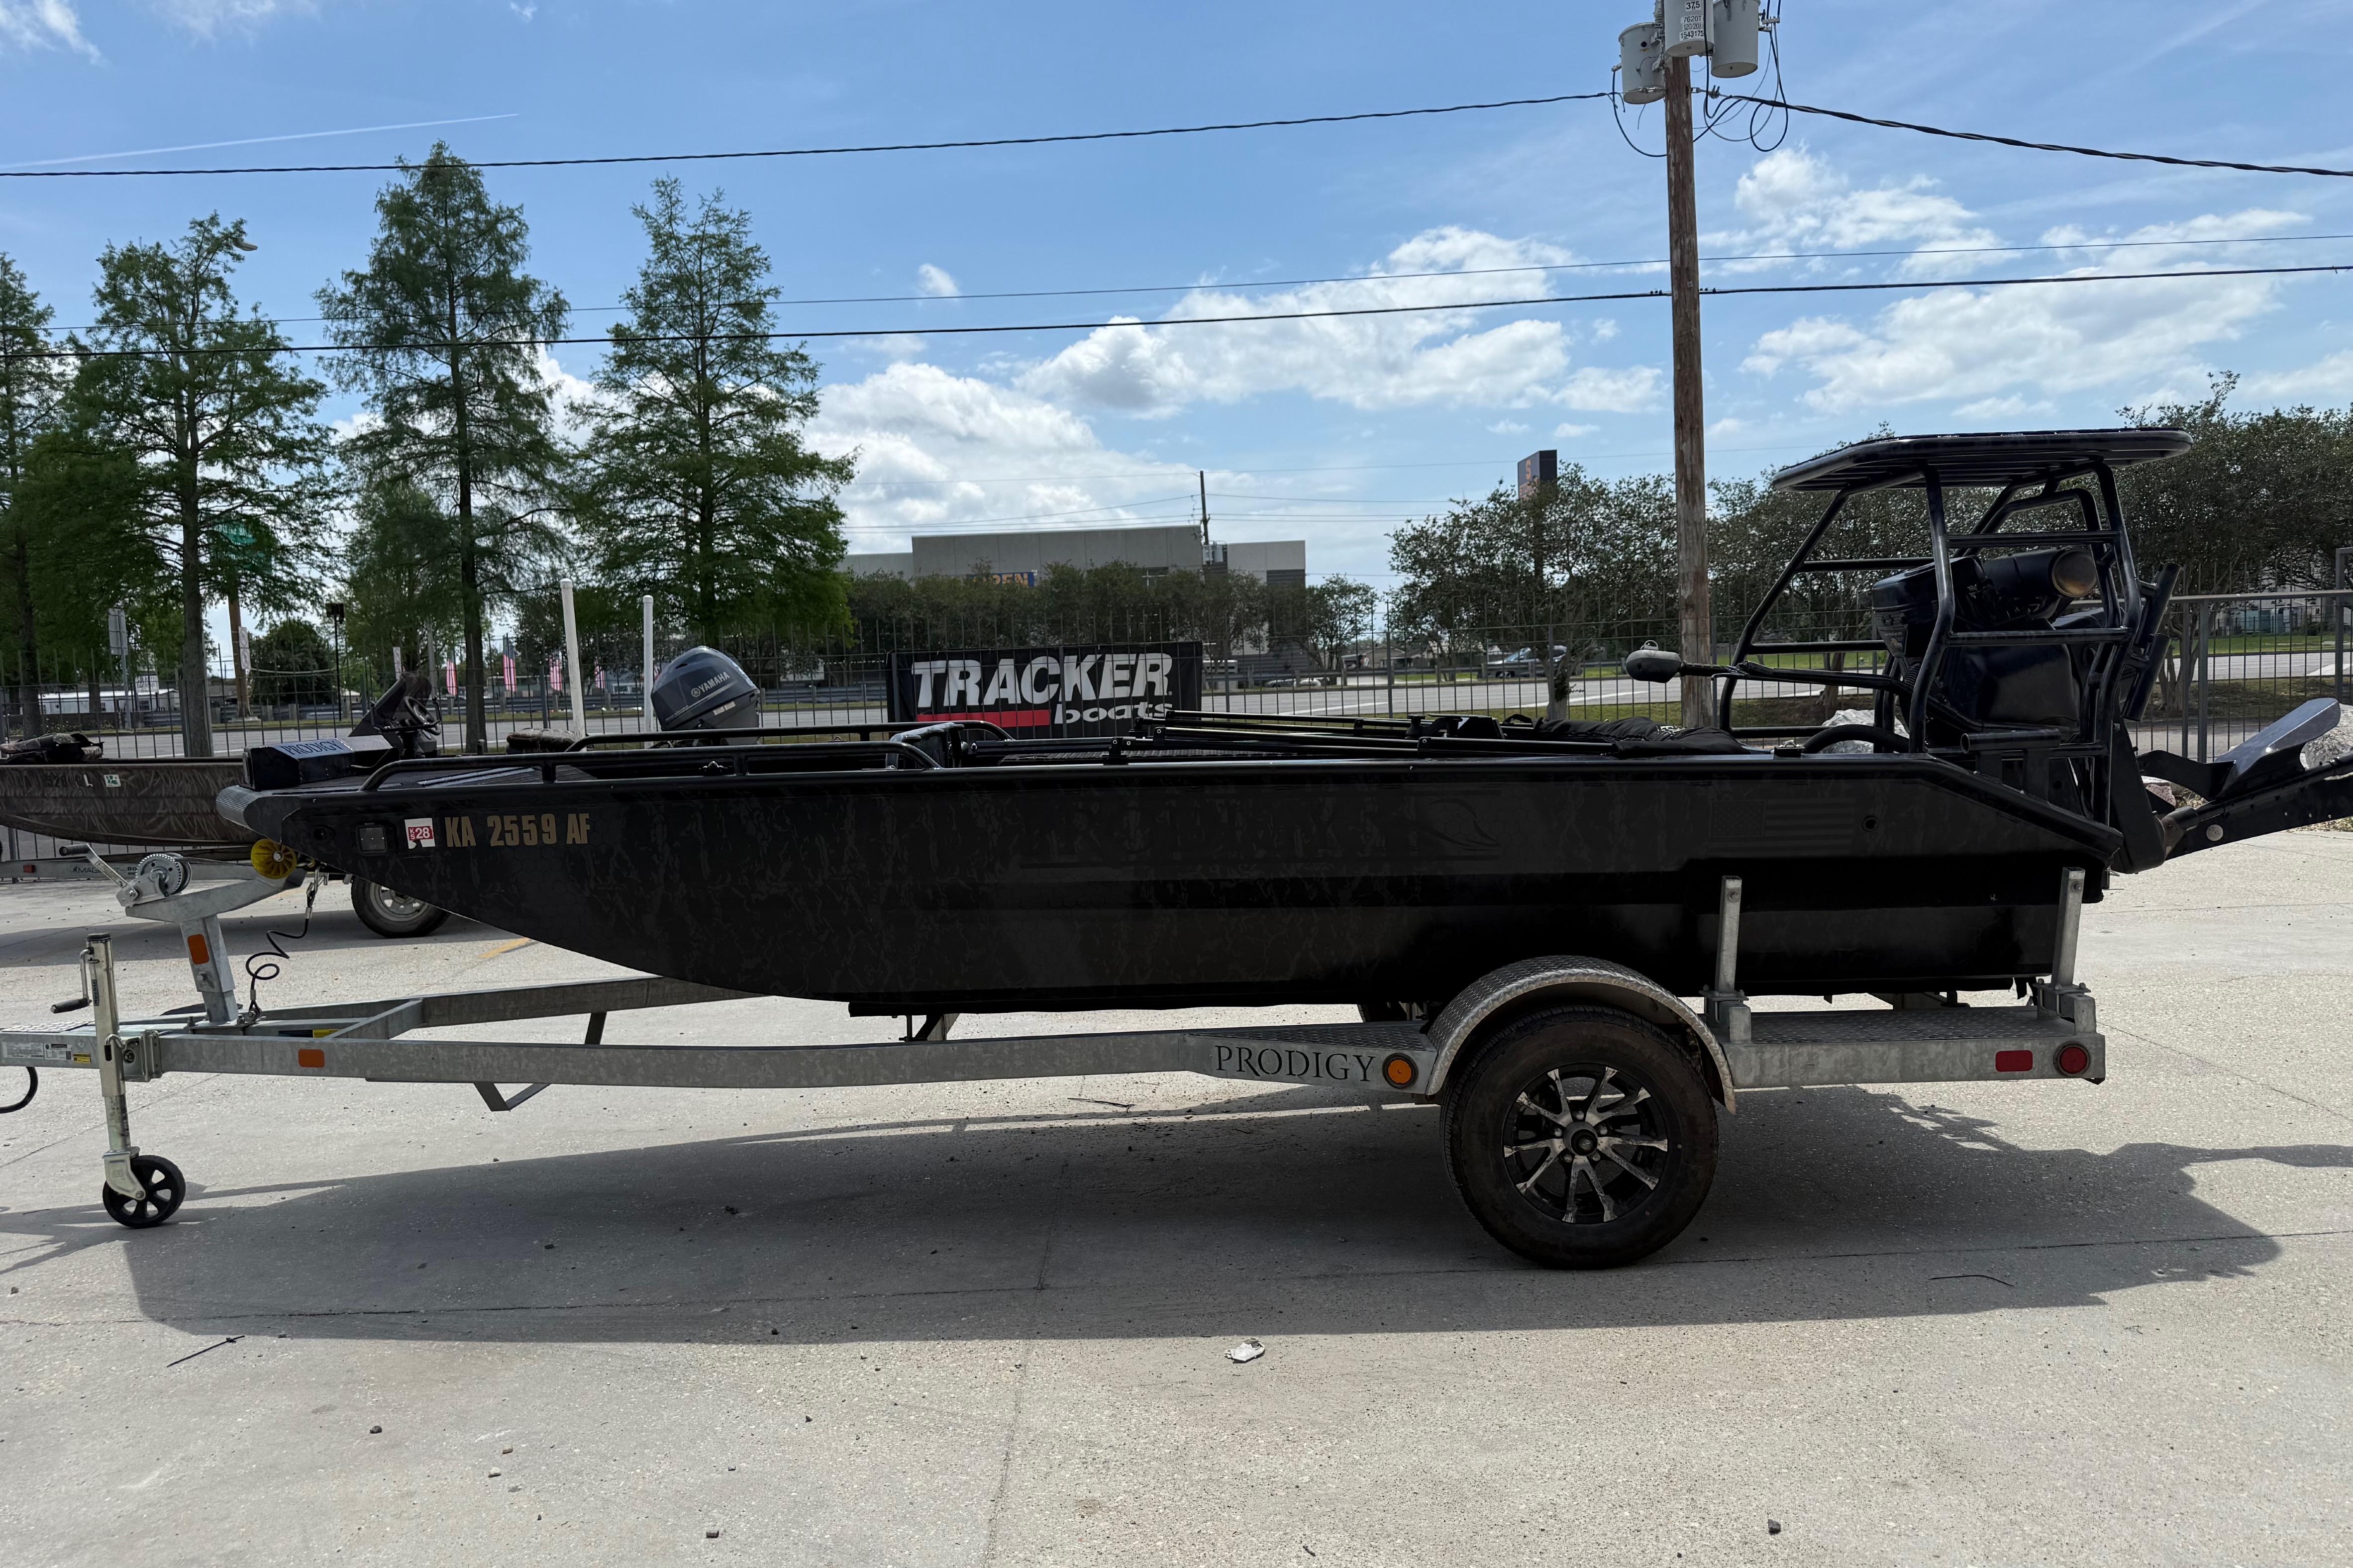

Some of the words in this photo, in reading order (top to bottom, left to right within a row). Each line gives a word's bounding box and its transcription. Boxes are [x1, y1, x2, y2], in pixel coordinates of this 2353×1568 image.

[1681, 30, 1704, 39] 1543175
[698, 672, 730, 693] YAMAHA
[911, 653, 1172, 708] TRACKER
[1054, 697, 1173, 724] boats
[279, 741, 343, 755] PRODIGY
[415, 827, 430, 839] 28
[445, 816, 477, 847] KA
[487, 814, 557, 846] 2559
[566, 813, 590, 844] AF
[1215, 1045, 1377, 1082] PRODIGY
